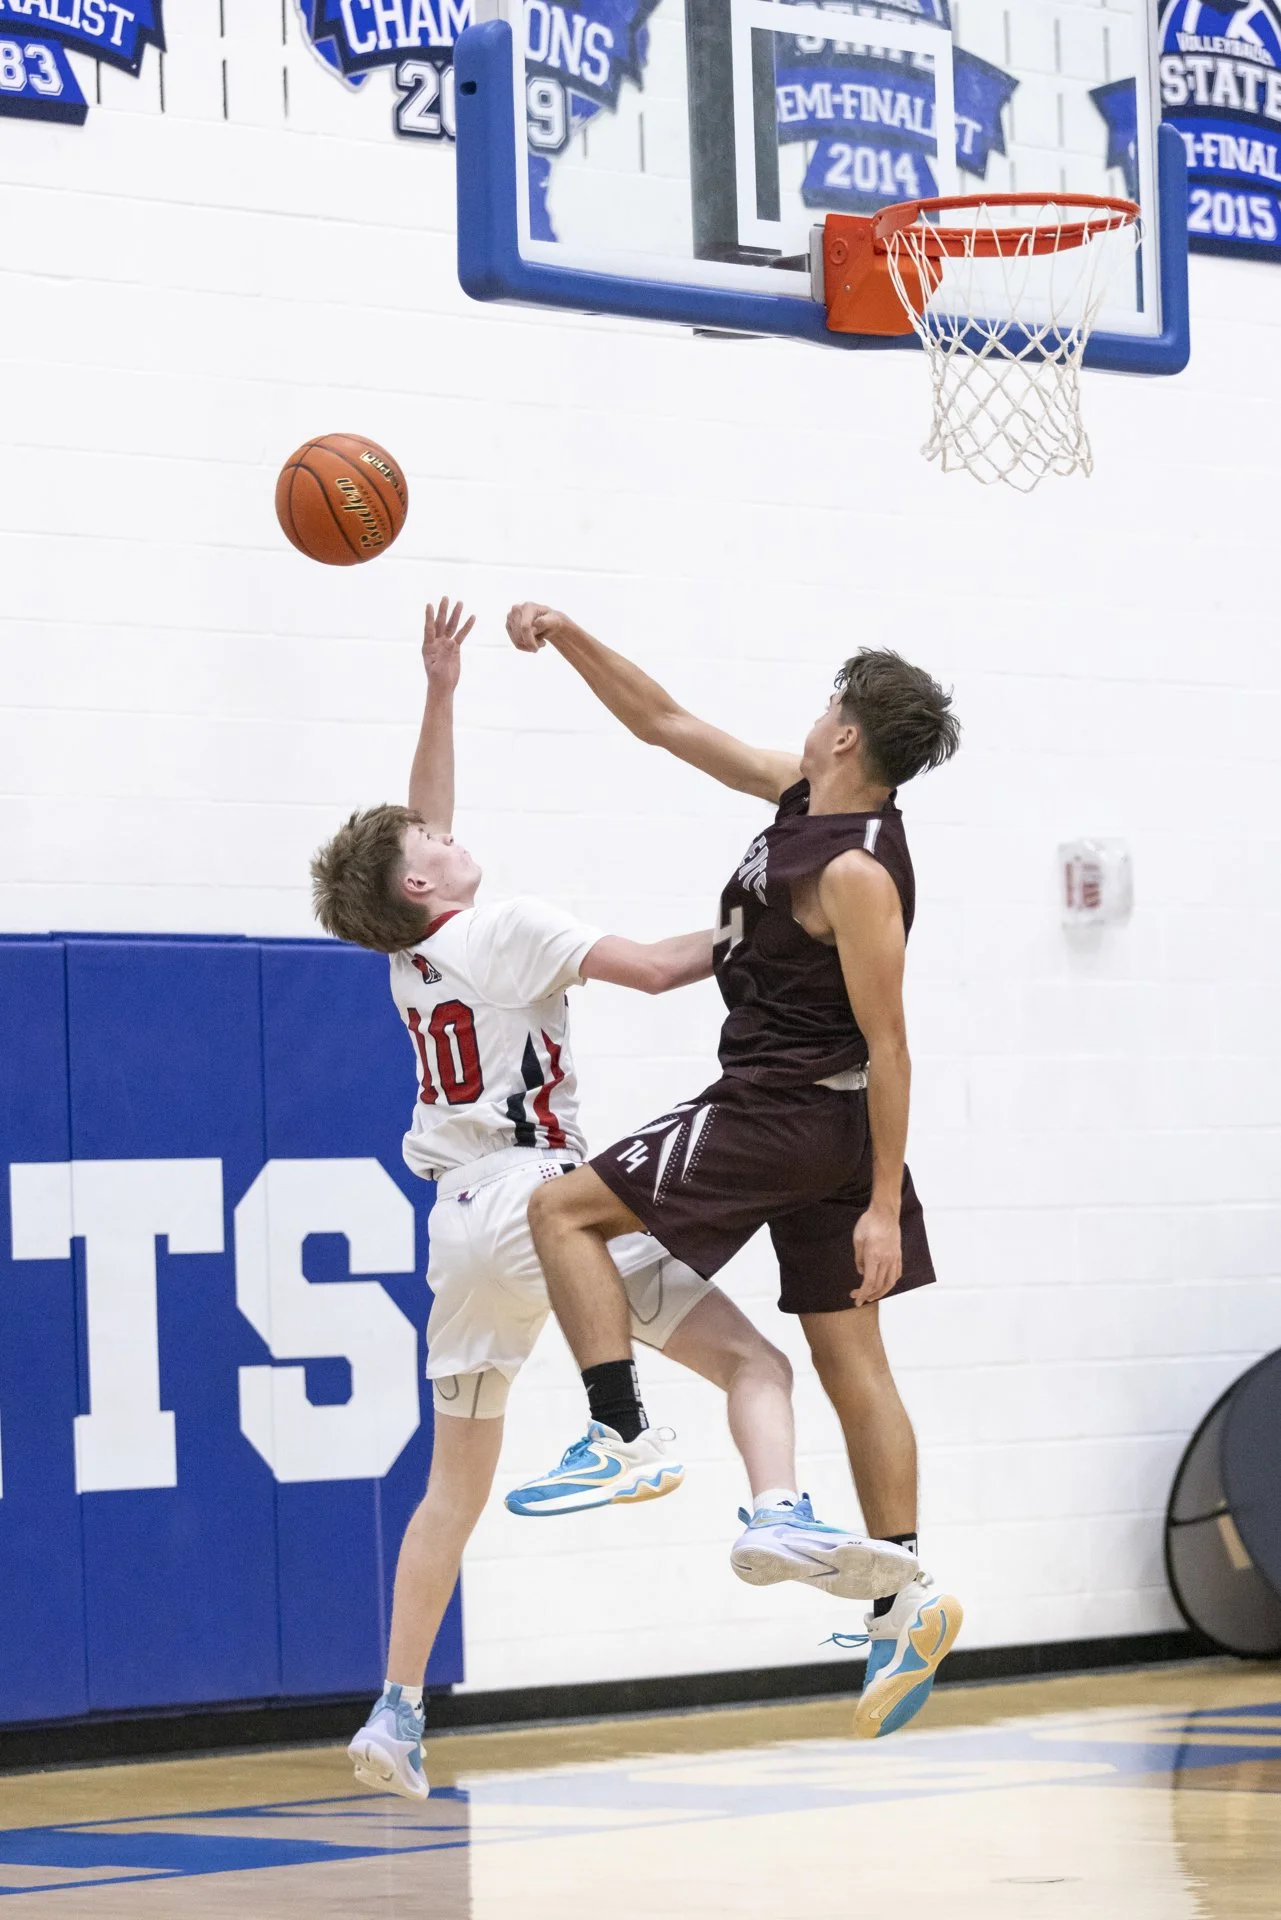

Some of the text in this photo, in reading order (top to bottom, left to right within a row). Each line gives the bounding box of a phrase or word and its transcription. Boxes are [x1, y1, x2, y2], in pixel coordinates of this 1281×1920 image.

[339, 0, 615, 86] CHAMONS
[776, 82, 984, 155] EMI-FINALT
[1160, 55, 1281, 122] STATE
[824, 143, 921, 198] 2014
[1186, 188, 1278, 242] 2015
[407, 998, 485, 1106] 10
[616, 1139, 650, 1174] 14
[0, 1157, 421, 1498] TS
